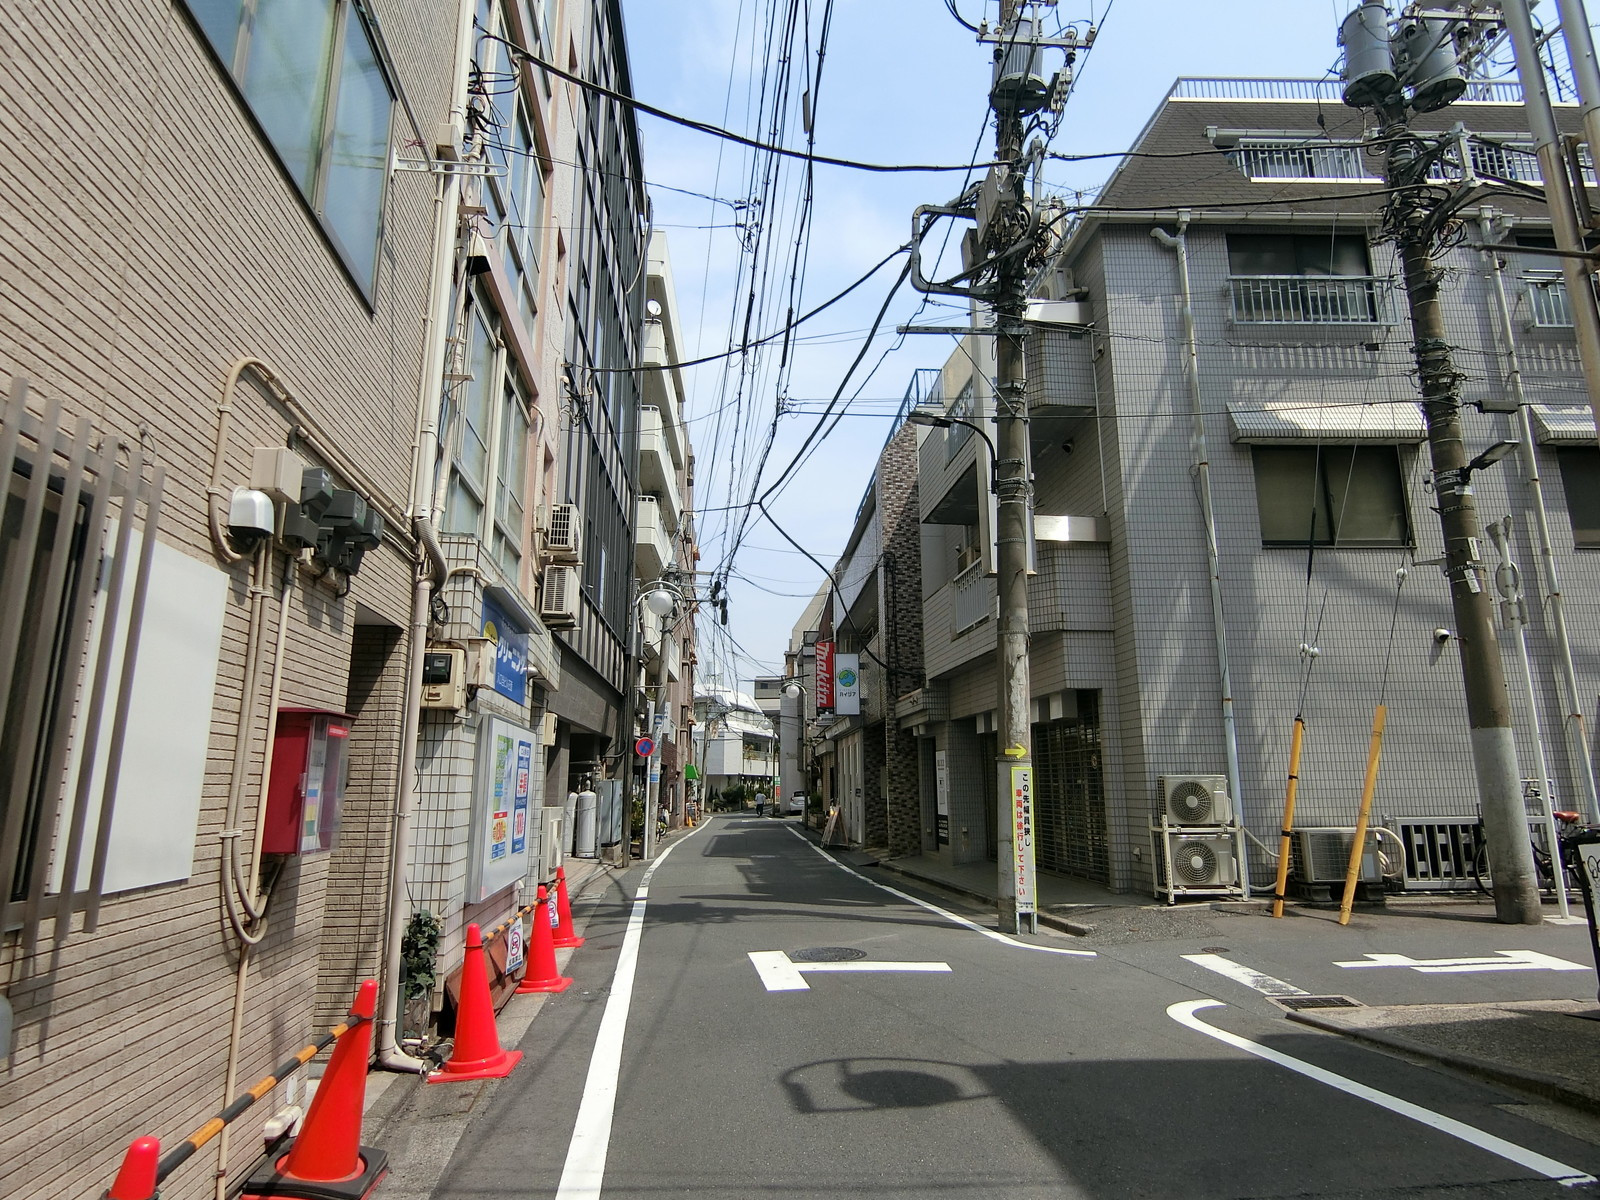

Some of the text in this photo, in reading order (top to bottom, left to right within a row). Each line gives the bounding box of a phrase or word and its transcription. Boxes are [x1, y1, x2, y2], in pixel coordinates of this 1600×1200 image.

[816, 642, 830, 707] Makita
[1015, 788, 1026, 896] 車両は徐行して下さい
[1022, 773, 1031, 847] この先幅員狭し
